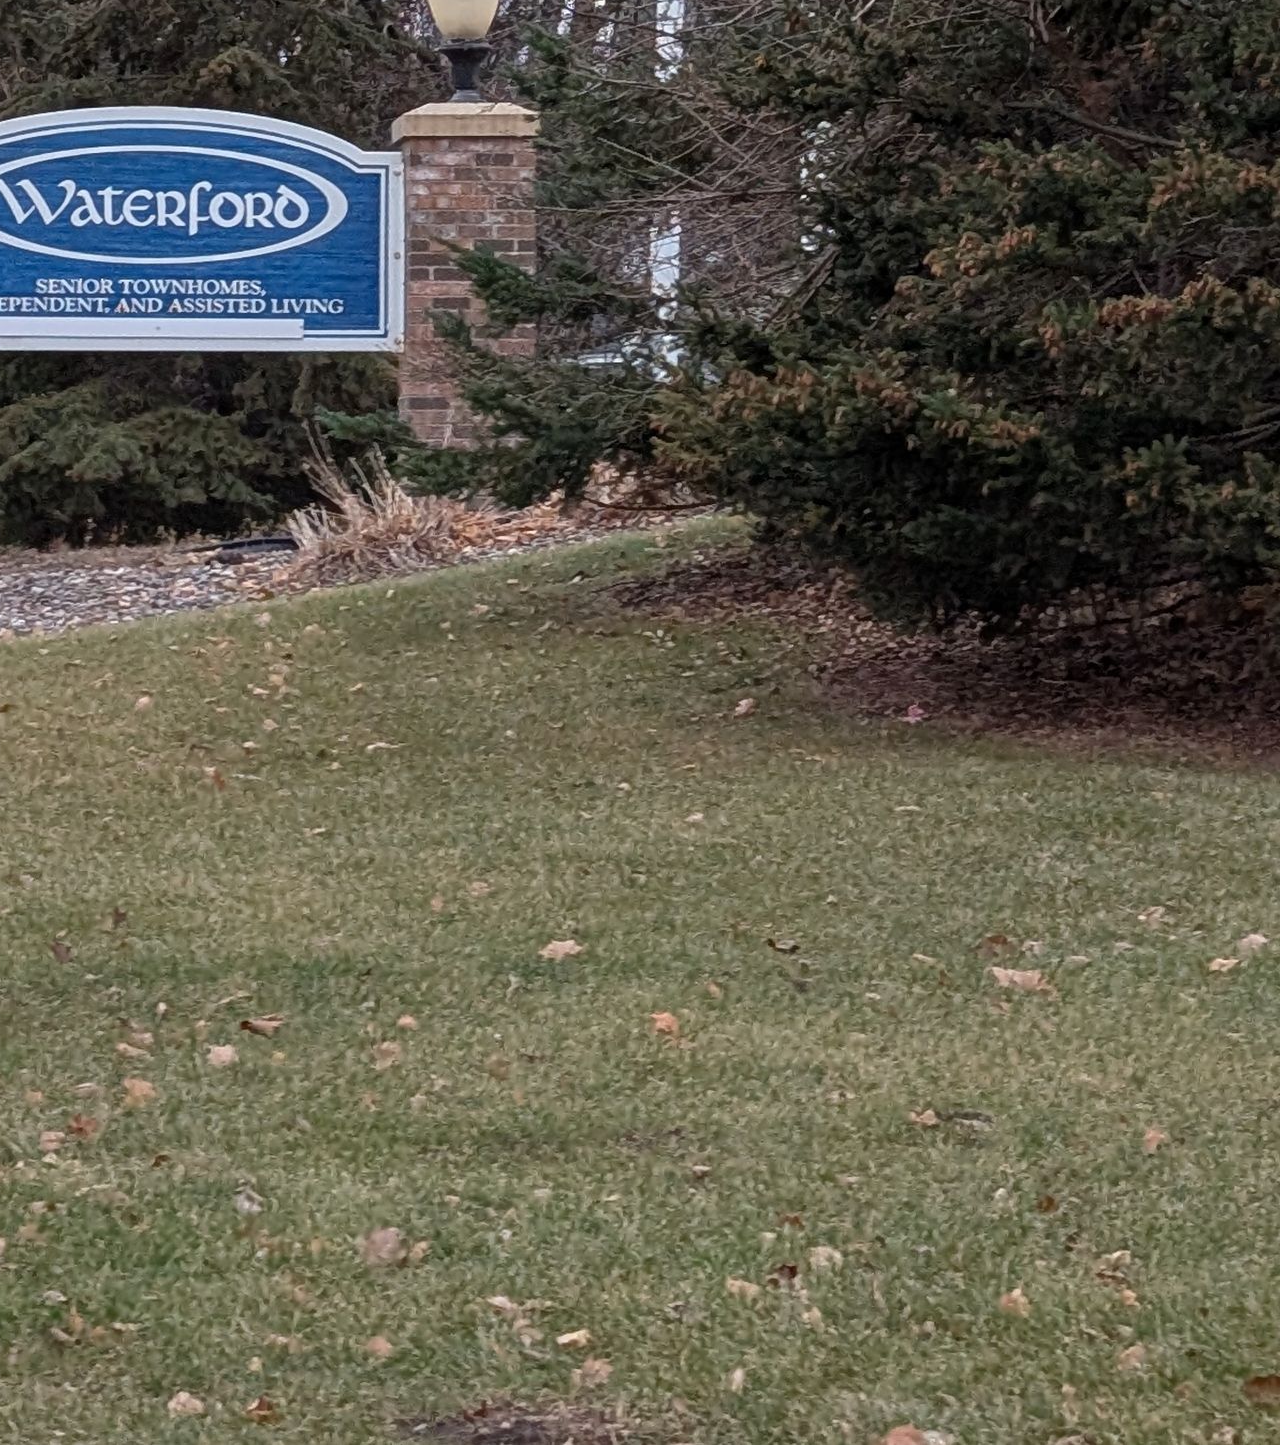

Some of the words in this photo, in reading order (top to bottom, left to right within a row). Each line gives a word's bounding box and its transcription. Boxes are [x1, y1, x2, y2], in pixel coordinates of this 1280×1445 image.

[35, 278, 115, 295] SENIOR
[118, 279, 267, 297] TOWNHOMES,
[114, 297, 163, 313] AND
[168, 297, 267, 314] ASSISTED
[270, 298, 344, 314] LIVING
